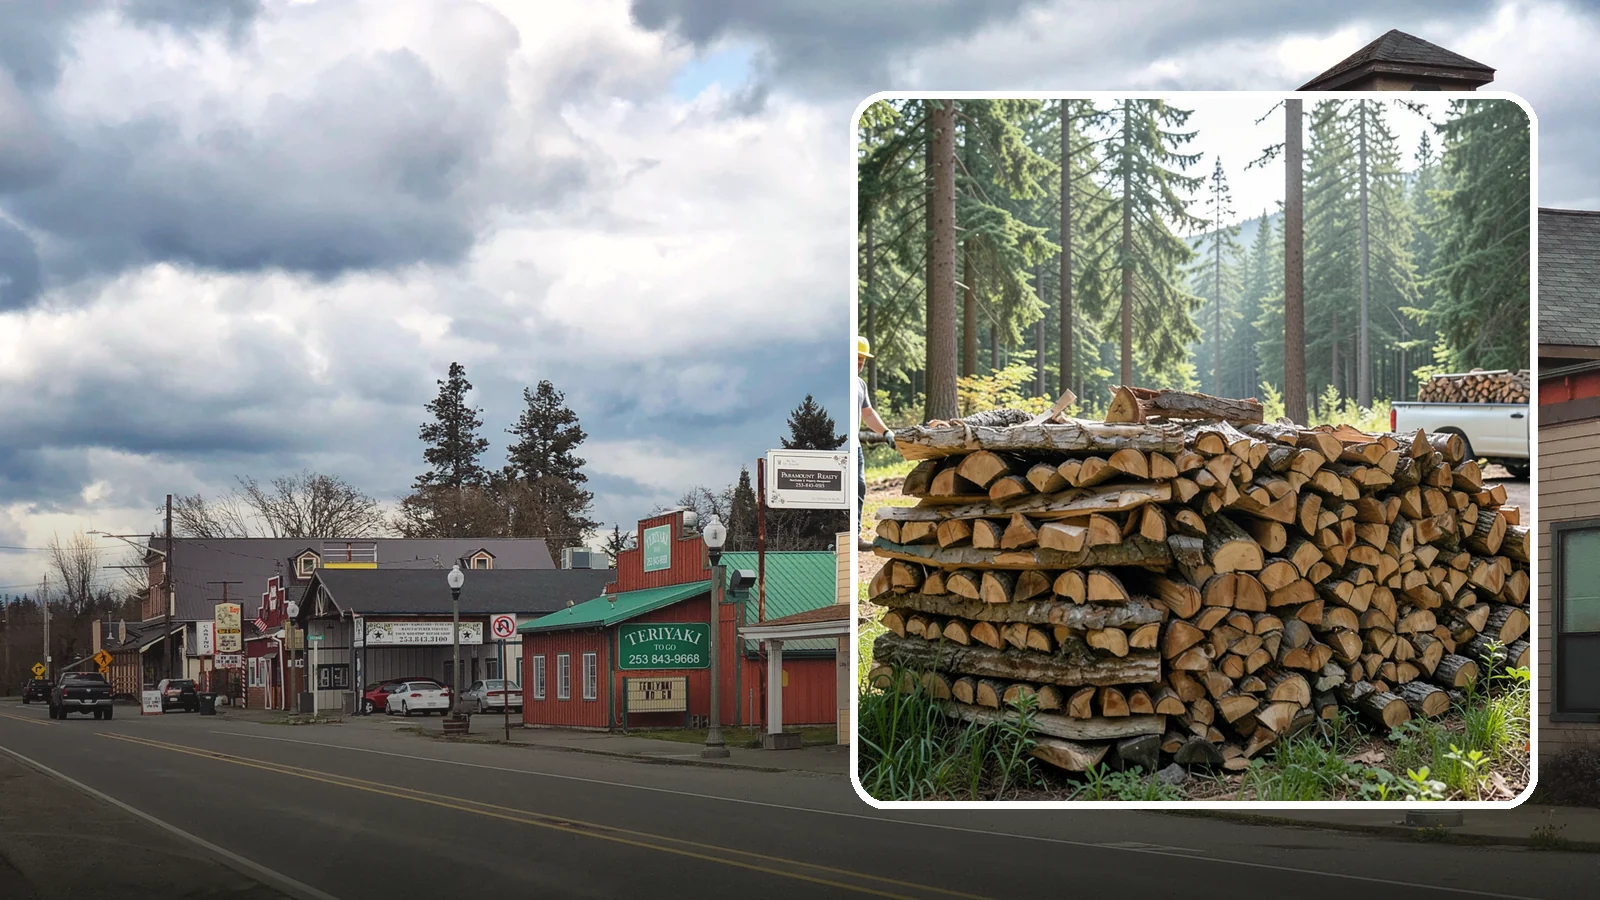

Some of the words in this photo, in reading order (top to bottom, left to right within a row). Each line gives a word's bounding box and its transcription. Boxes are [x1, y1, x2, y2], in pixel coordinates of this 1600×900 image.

[781, 471, 815, 479] PARAMOUNT
[817, 472, 839, 480] REALTY
[625, 627, 702, 646] TERIYAKI
[628, 654, 649, 665] 253
[651, 653, 700, 664] 843-9668
